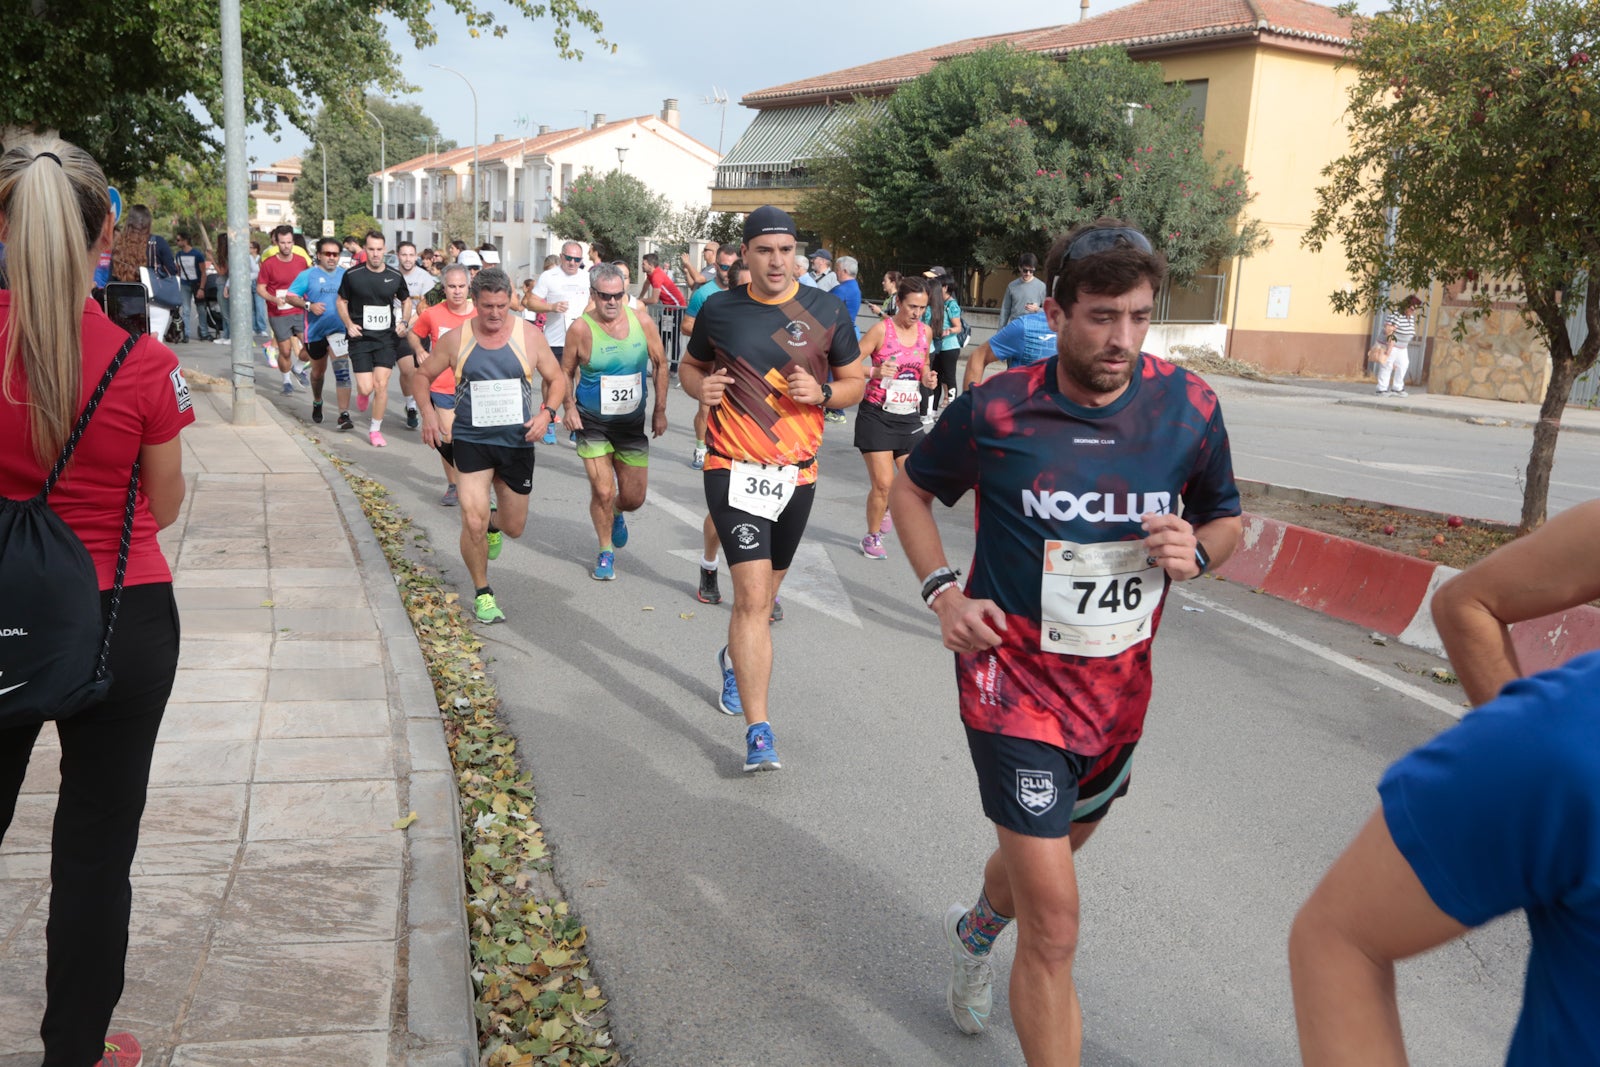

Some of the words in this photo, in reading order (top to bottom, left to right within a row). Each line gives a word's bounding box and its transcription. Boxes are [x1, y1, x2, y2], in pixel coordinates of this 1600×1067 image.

[367, 315, 388, 323] 3101
[611, 387, 634, 402] 321
[892, 392, 918, 403] 2044
[744, 476, 784, 500] 364
[1072, 576, 1143, 614] 746
[1020, 777, 1054, 789] CLUB
